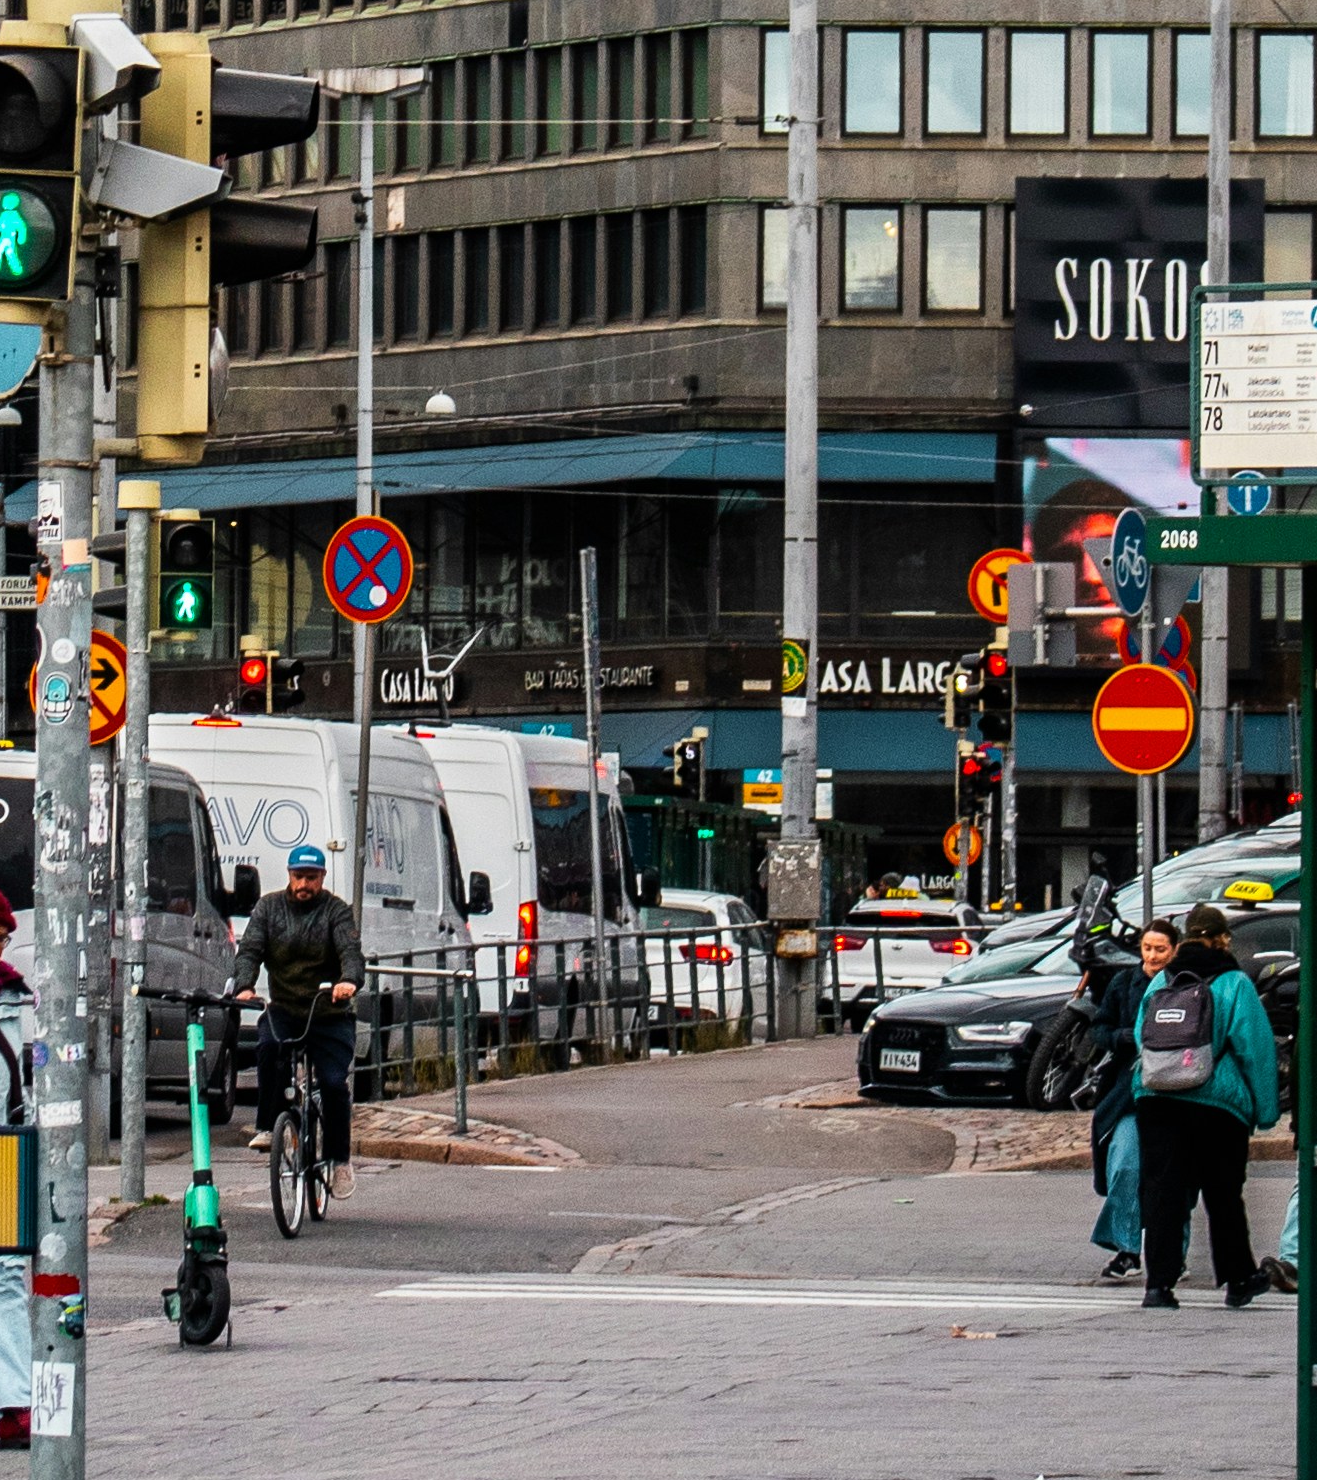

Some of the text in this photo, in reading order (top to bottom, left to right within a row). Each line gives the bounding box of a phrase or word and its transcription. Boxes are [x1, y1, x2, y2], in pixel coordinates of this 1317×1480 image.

[1203, 340, 1219, 365] 71
[1203, 406, 1223, 431] 78
[1160, 529, 1198, 549] 2068
[0, 595, 36, 607] KAMPP
[381, 668, 412, 703] CASA
[524, 665, 654, 691] BAR TAPAS STAURANTE
[817, 657, 951, 694] ASA LARG
[539, 724, 556, 736] 42
[756, 769, 774, 783] 42
[205, 796, 310, 849] AVO
[218, 855, 261, 866] URMET
[1232, 883, 1259, 895] TAKSI
